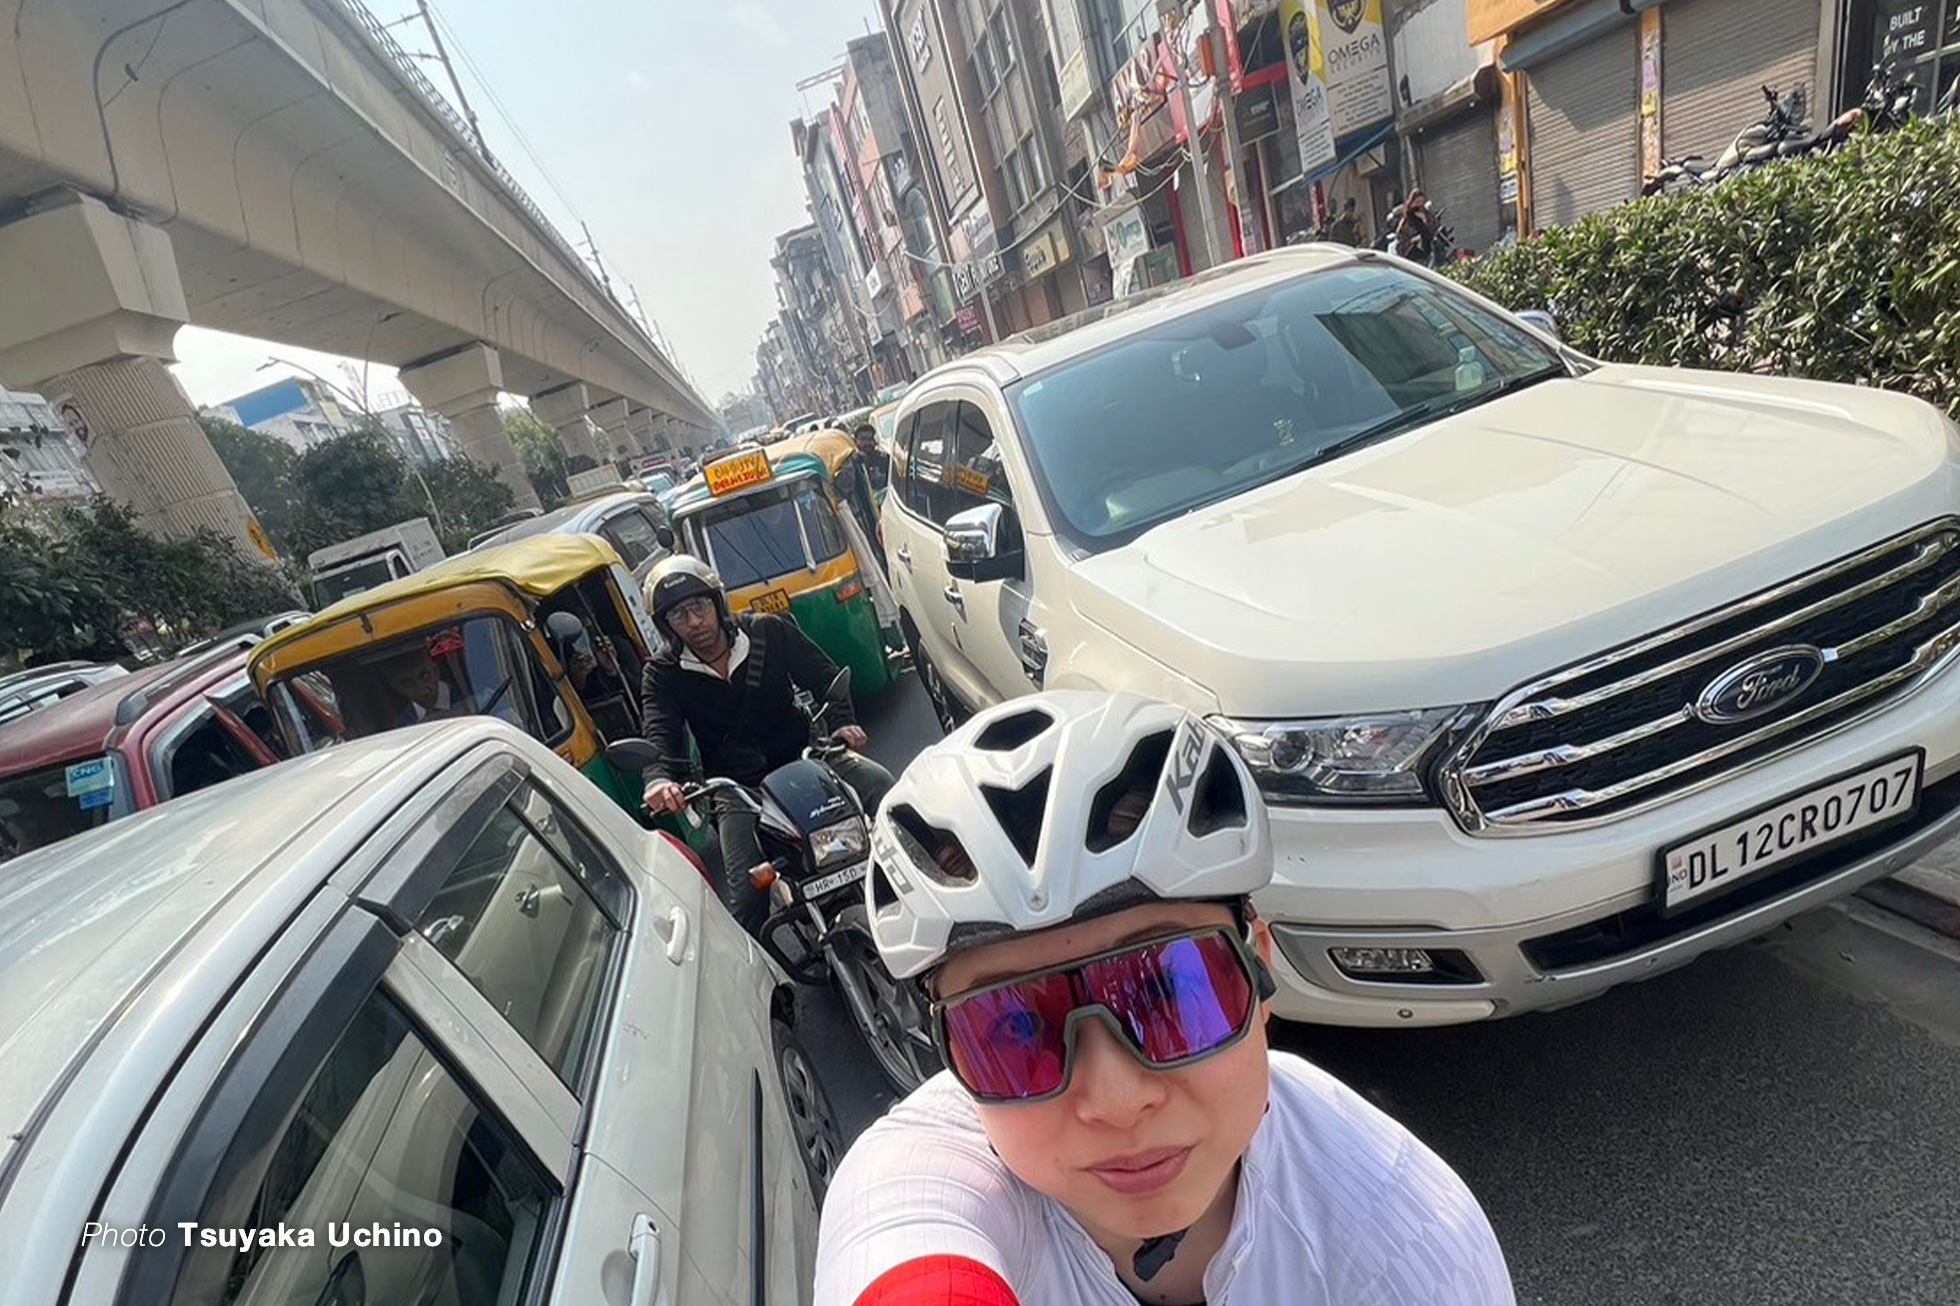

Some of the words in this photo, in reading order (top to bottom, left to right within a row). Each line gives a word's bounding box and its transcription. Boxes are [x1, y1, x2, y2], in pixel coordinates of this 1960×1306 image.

[1890, 6, 1922, 31] BUILT
[1328, 33, 1381, 64] OMEGA
[1903, 29, 1926, 50] THE
[1736, 665, 1801, 710] Ford
